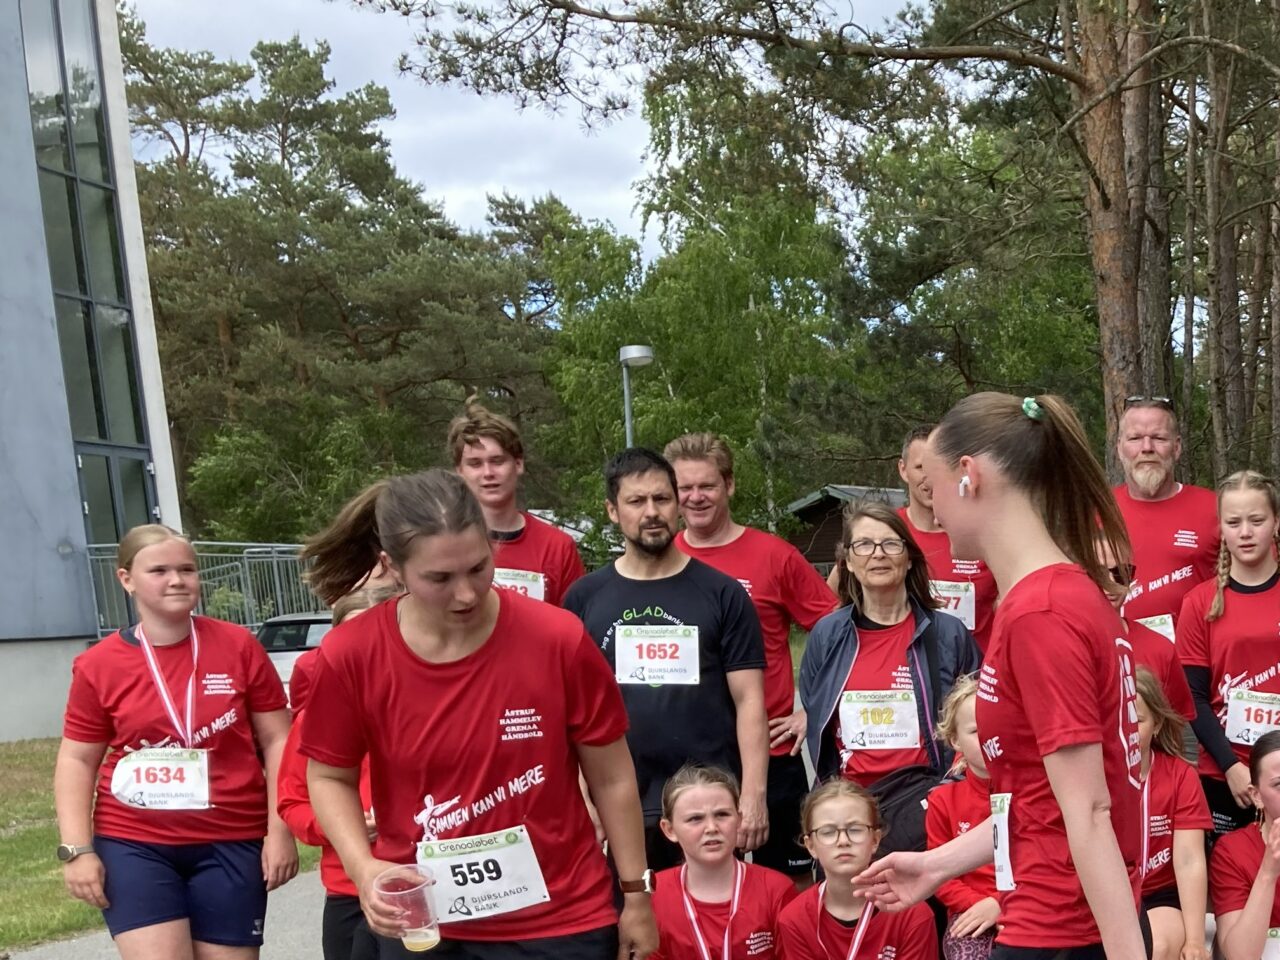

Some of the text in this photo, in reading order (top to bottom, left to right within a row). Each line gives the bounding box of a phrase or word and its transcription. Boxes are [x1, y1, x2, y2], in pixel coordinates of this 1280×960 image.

[1171, 565, 1193, 582] MERE
[623, 606, 664, 621] GLAD
[635, 643, 680, 660] 1652
[210, 708, 238, 734] MERE
[500, 716, 542, 725] HAMMELEV
[504, 709, 535, 717] ÅSTRUP
[859, 706, 895, 726] 102
[501, 731, 543, 741] HÅNDBOLD
[505, 724, 538, 732] GRENAA
[133, 767, 186, 784] 1634
[429, 765, 546, 836] SAMMEN KAN VI MERE
[438, 836, 498, 853] Grenaaløbet
[450, 858, 503, 887] 559
[471, 885, 529, 904] DJURSLANDS
[474, 902, 500, 912] BANK
